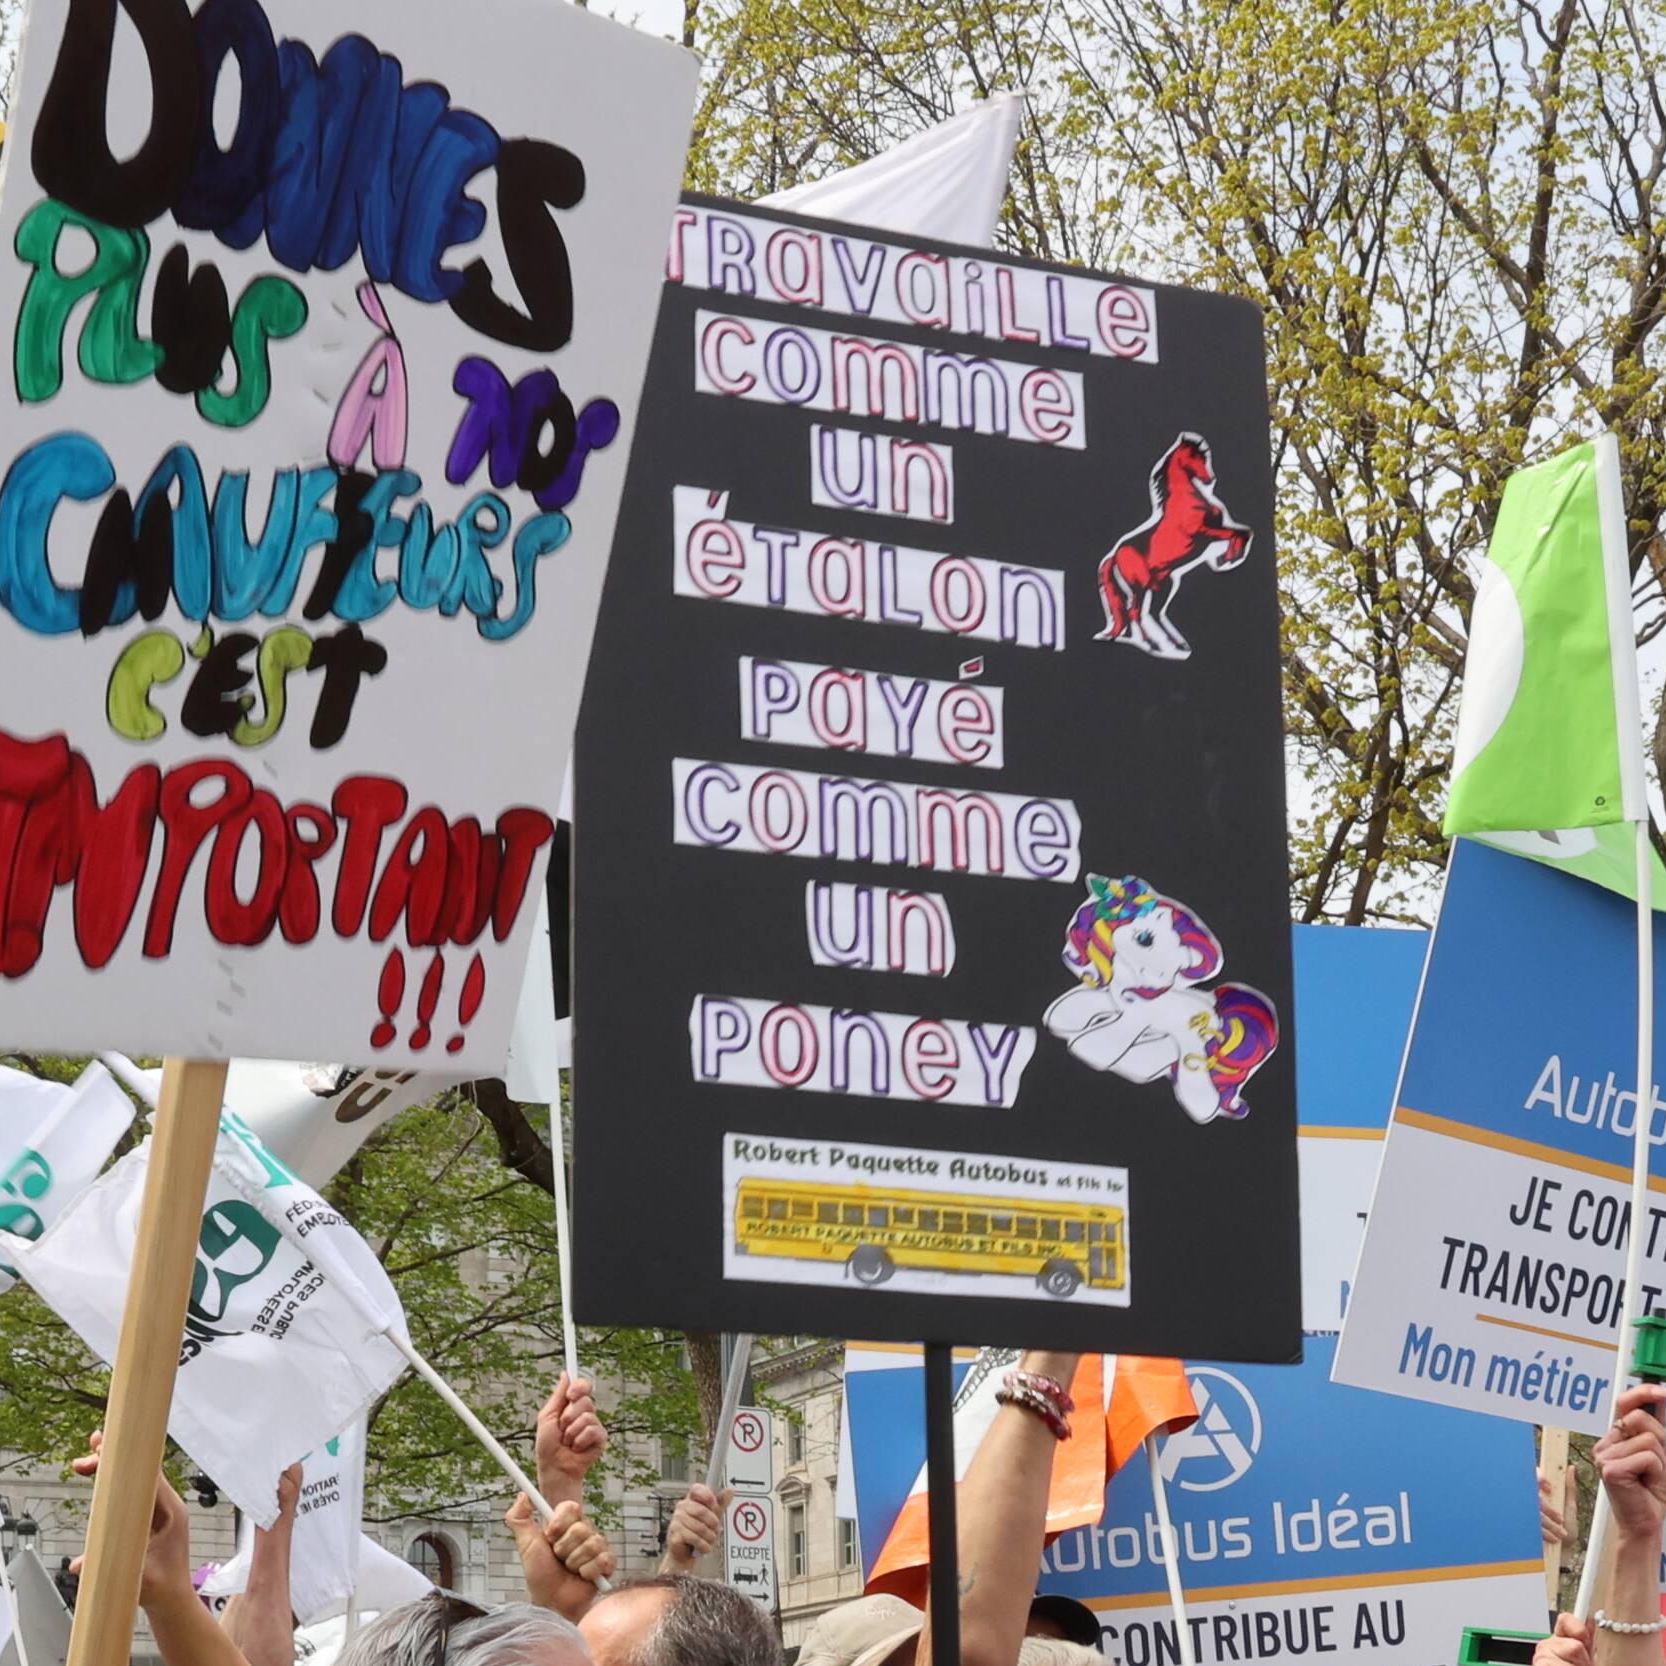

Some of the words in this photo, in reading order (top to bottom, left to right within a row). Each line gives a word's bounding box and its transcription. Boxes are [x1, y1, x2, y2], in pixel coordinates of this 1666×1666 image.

[31, 0, 586, 352] DONNES
[13, 198, 308, 428] PLUS
[445, 356, 620, 510] NOS
[817, 426, 949, 520] un
[107, 621, 388, 751] C'EST
[812, 886, 948, 976] un
[734, 1139, 820, 1165] Robert
[829, 1148, 940, 1176] Paquette
[949, 1158, 1048, 1186] Autobus
[1509, 1176, 1559, 1234] JE
[1398, 1322, 1474, 1384] Mon
[1489, 1341, 1609, 1415] métier
[730, 1544, 771, 1561] EXCEPTÉ
[1272, 1490, 1413, 1555] Idéal
[1352, 1599, 1406, 1649] AU
